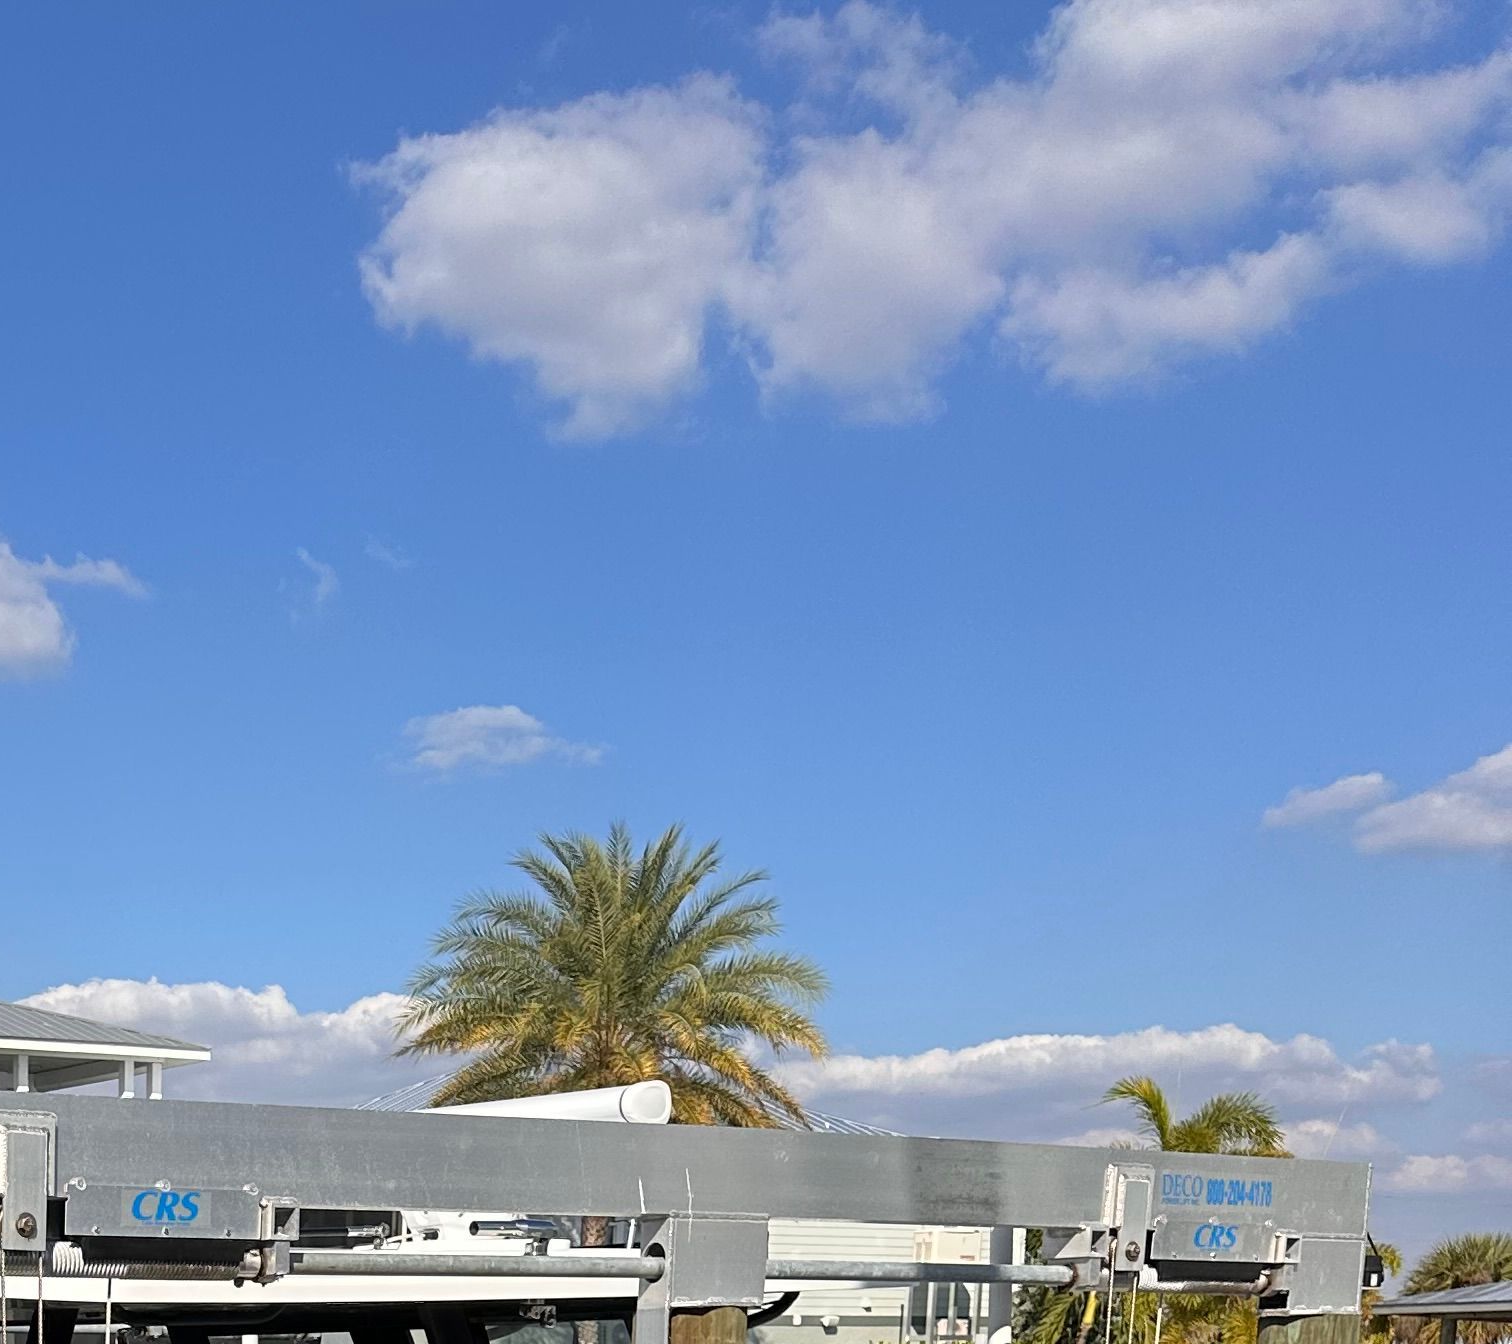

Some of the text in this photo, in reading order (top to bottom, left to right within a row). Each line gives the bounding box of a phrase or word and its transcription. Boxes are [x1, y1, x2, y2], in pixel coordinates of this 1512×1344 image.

[1162, 1174, 1204, 1197] DECO
[131, 1189, 201, 1221] CRS
[1193, 1223, 1238, 1248] CRS
